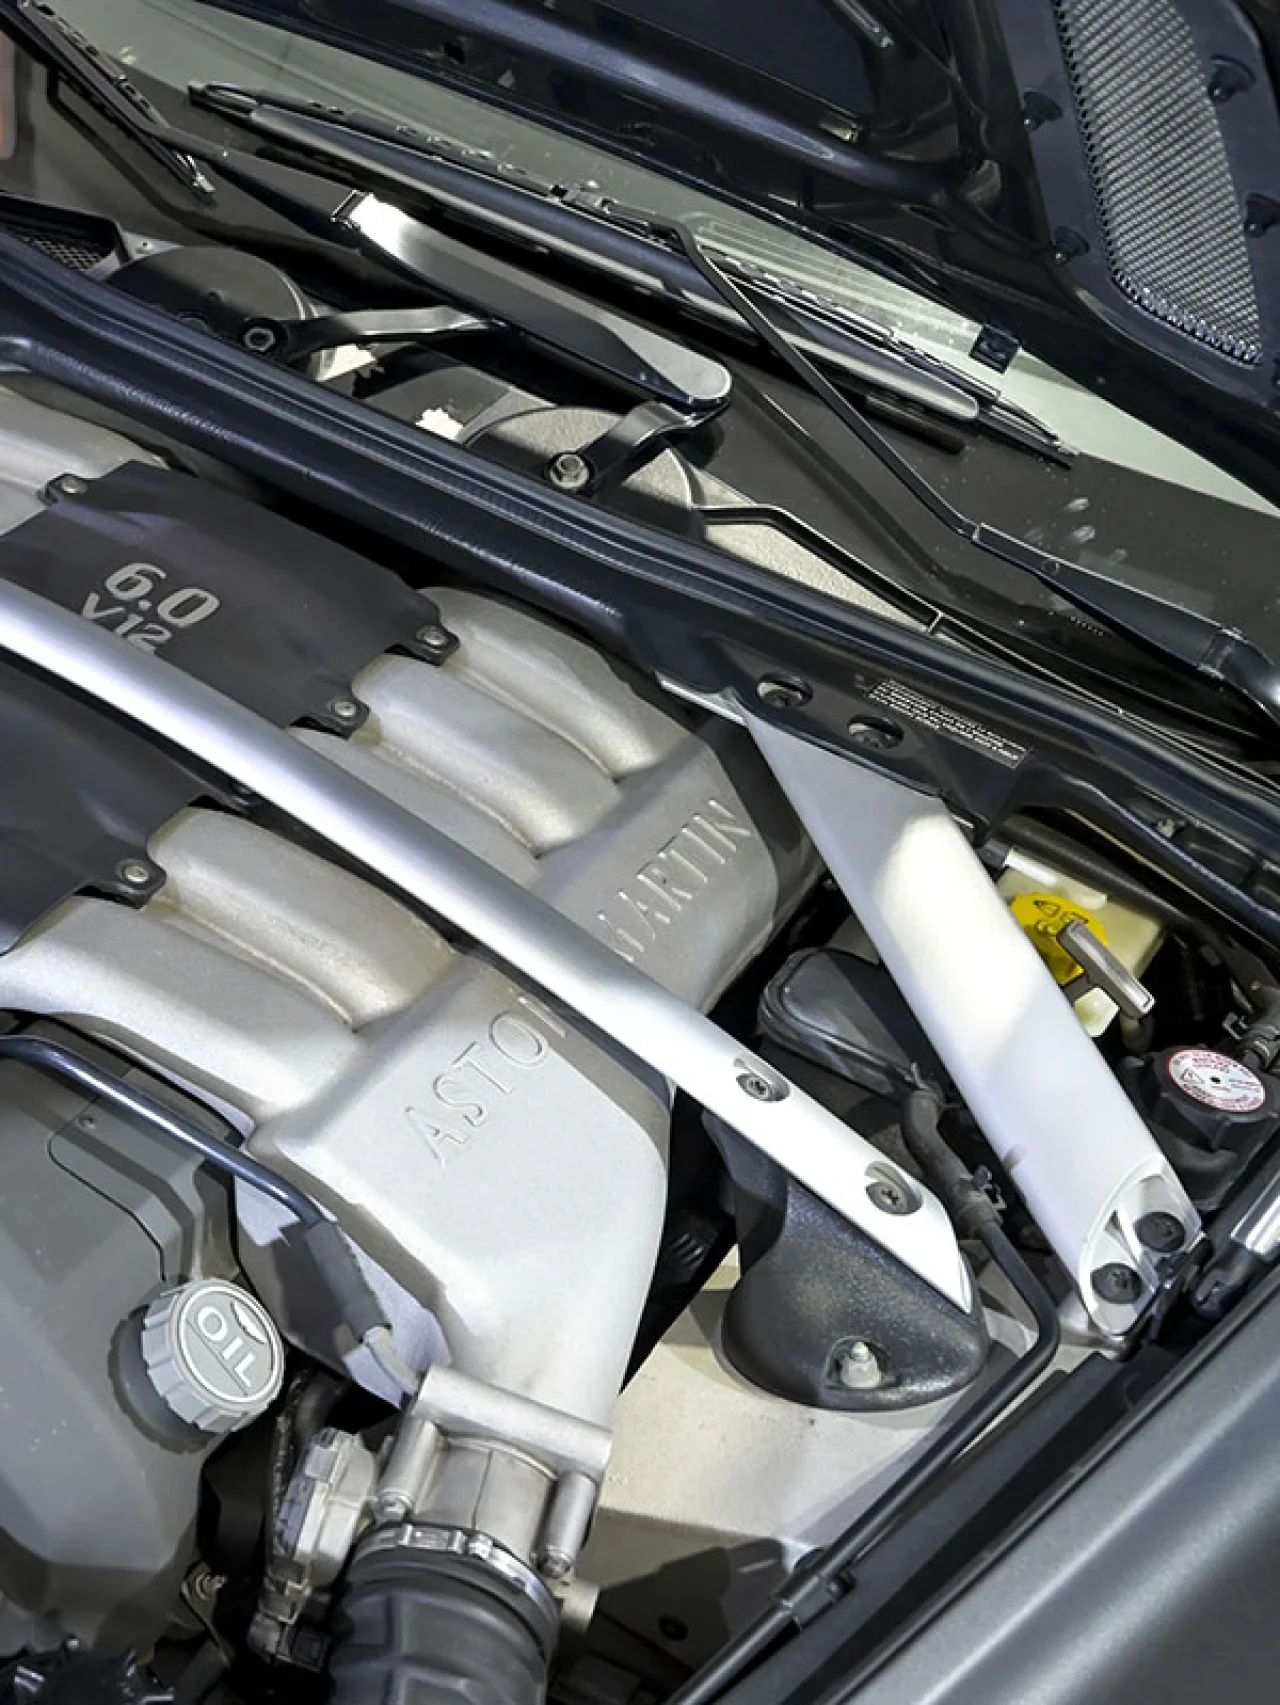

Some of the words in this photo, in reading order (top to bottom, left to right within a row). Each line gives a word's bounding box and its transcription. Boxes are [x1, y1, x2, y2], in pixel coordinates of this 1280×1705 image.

[82, 592, 171, 650] V12
[105, 562, 220, 627] 6.0
[196, 1306, 256, 1388] OIL
